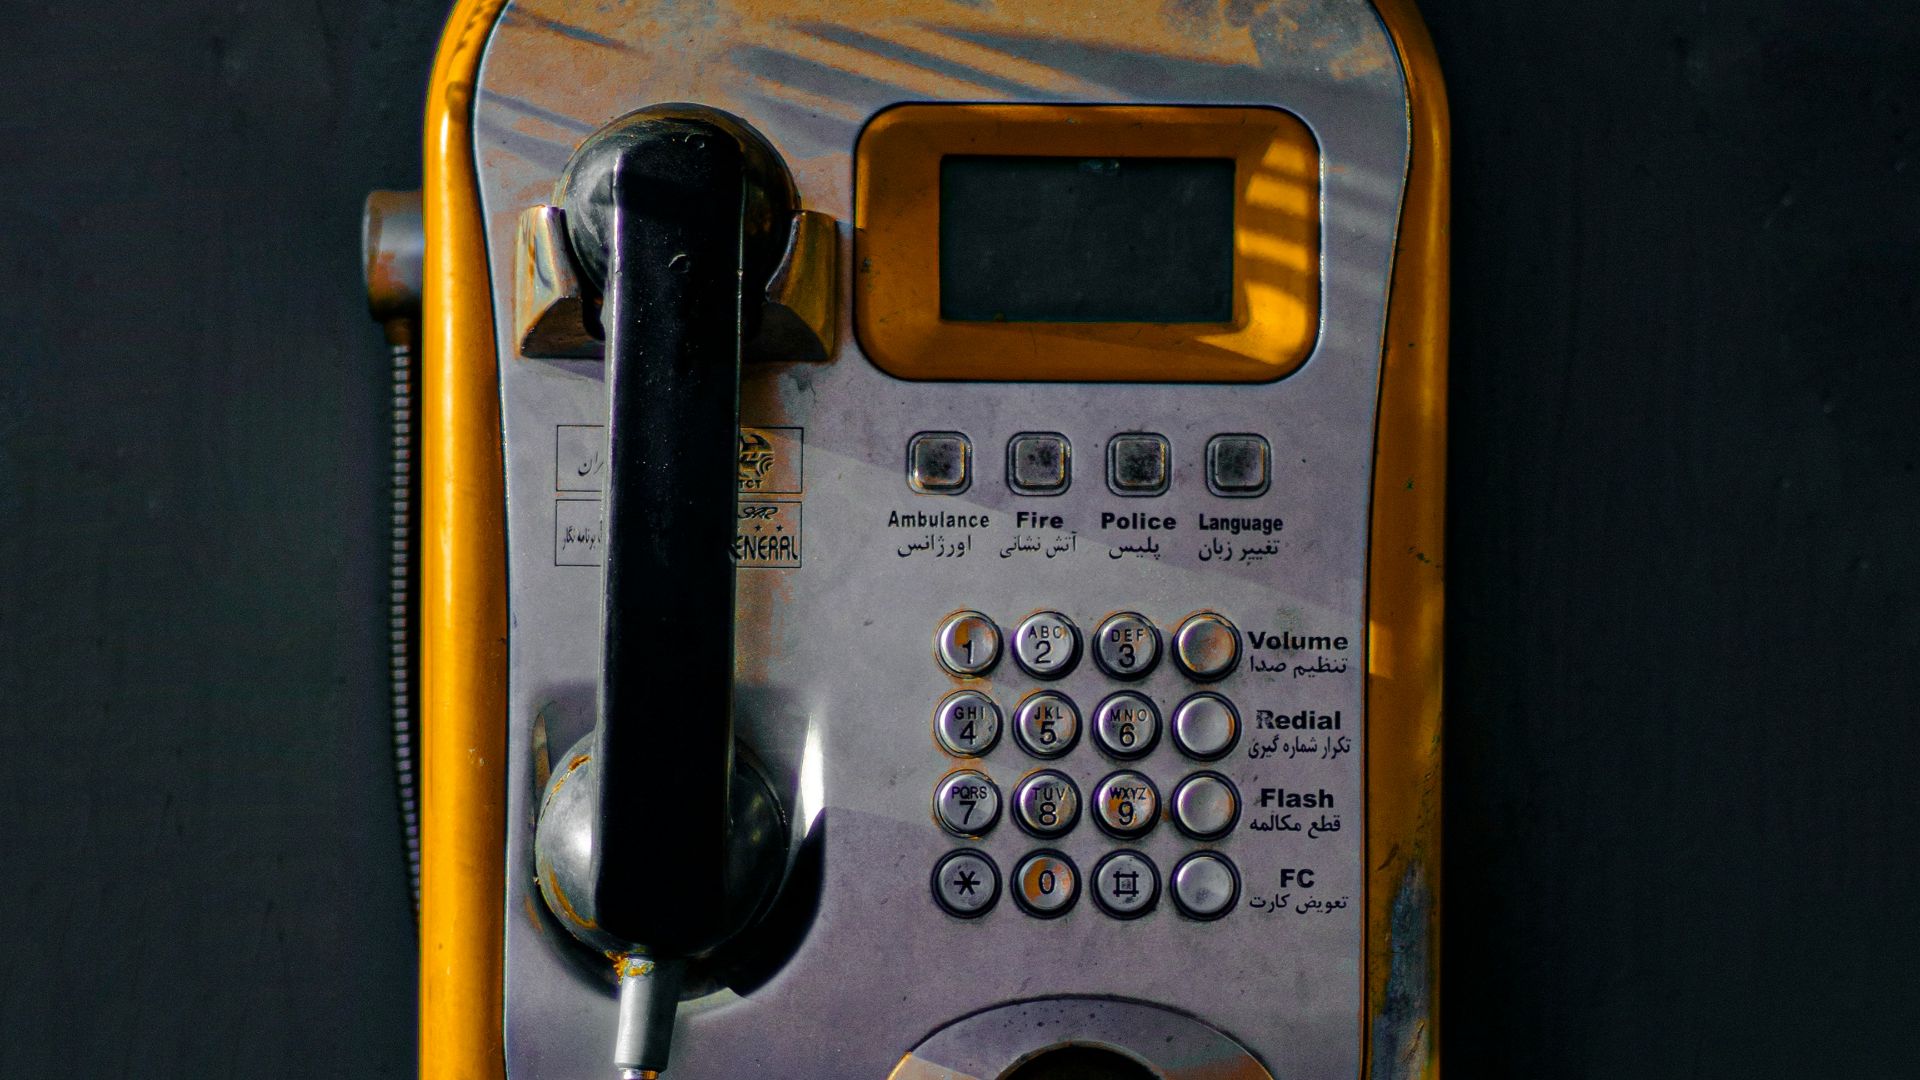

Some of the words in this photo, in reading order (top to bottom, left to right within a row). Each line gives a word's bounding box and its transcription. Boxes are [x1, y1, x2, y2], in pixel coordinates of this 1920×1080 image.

[888, 510, 990, 528] Ambulance
[1016, 511, 1064, 529] Fire
[1101, 512, 1177, 530] Police
[1199, 513, 1283, 535] Language
[735, 535, 799, 560] ENERAL
[897, 535, 972, 558] اورژانس
[999, 534, 1041, 558] نشانی
[1045, 531, 1078, 558] آتش
[1108, 536, 1160, 560] پلیس
[1198, 537, 1233, 561] زبان
[1238, 540, 1280, 565] تغییر
[1027, 625, 1064, 640] ABC
[1111, 628, 1145, 643] DEF
[1247, 631, 1349, 650] Volume
[962, 639, 975, 664] 1
[1034, 641, 1052, 664] 2
[1118, 643, 1136, 668] 3
[1250, 655, 1287, 673] صدا
[1293, 656, 1348, 679] تنظیم
[953, 706, 985, 720] GHI
[1034, 705, 1064, 720] JKL
[1109, 708, 1148, 723] MNO
[1256, 709, 1341, 730] Redial
[959, 720, 977, 745] 4
[1039, 720, 1057, 745] 5
[1118, 722, 1135, 747] 6
[1248, 734, 1280, 760] گیری
[1282, 736, 1318, 760] شماره
[1320, 736, 1352, 760] تکرار
[951, 785, 988, 801] PQRS
[1033, 786, 1066, 801] TUV
[1109, 786, 1146, 800] WXYZ
[1260, 788, 1335, 809] Flash
[959, 800, 976, 825] 7
[1038, 801, 1057, 826] 8
[1117, 800, 1135, 826] 9
[1249, 814, 1302, 832] مکالمه
[1307, 814, 1341, 839] قطع
[1038, 869, 1056, 895] 0
[1280, 868, 1315, 889] FC
[1249, 893, 1290, 913] کارت
[1295, 895, 1349, 915] تعویض
